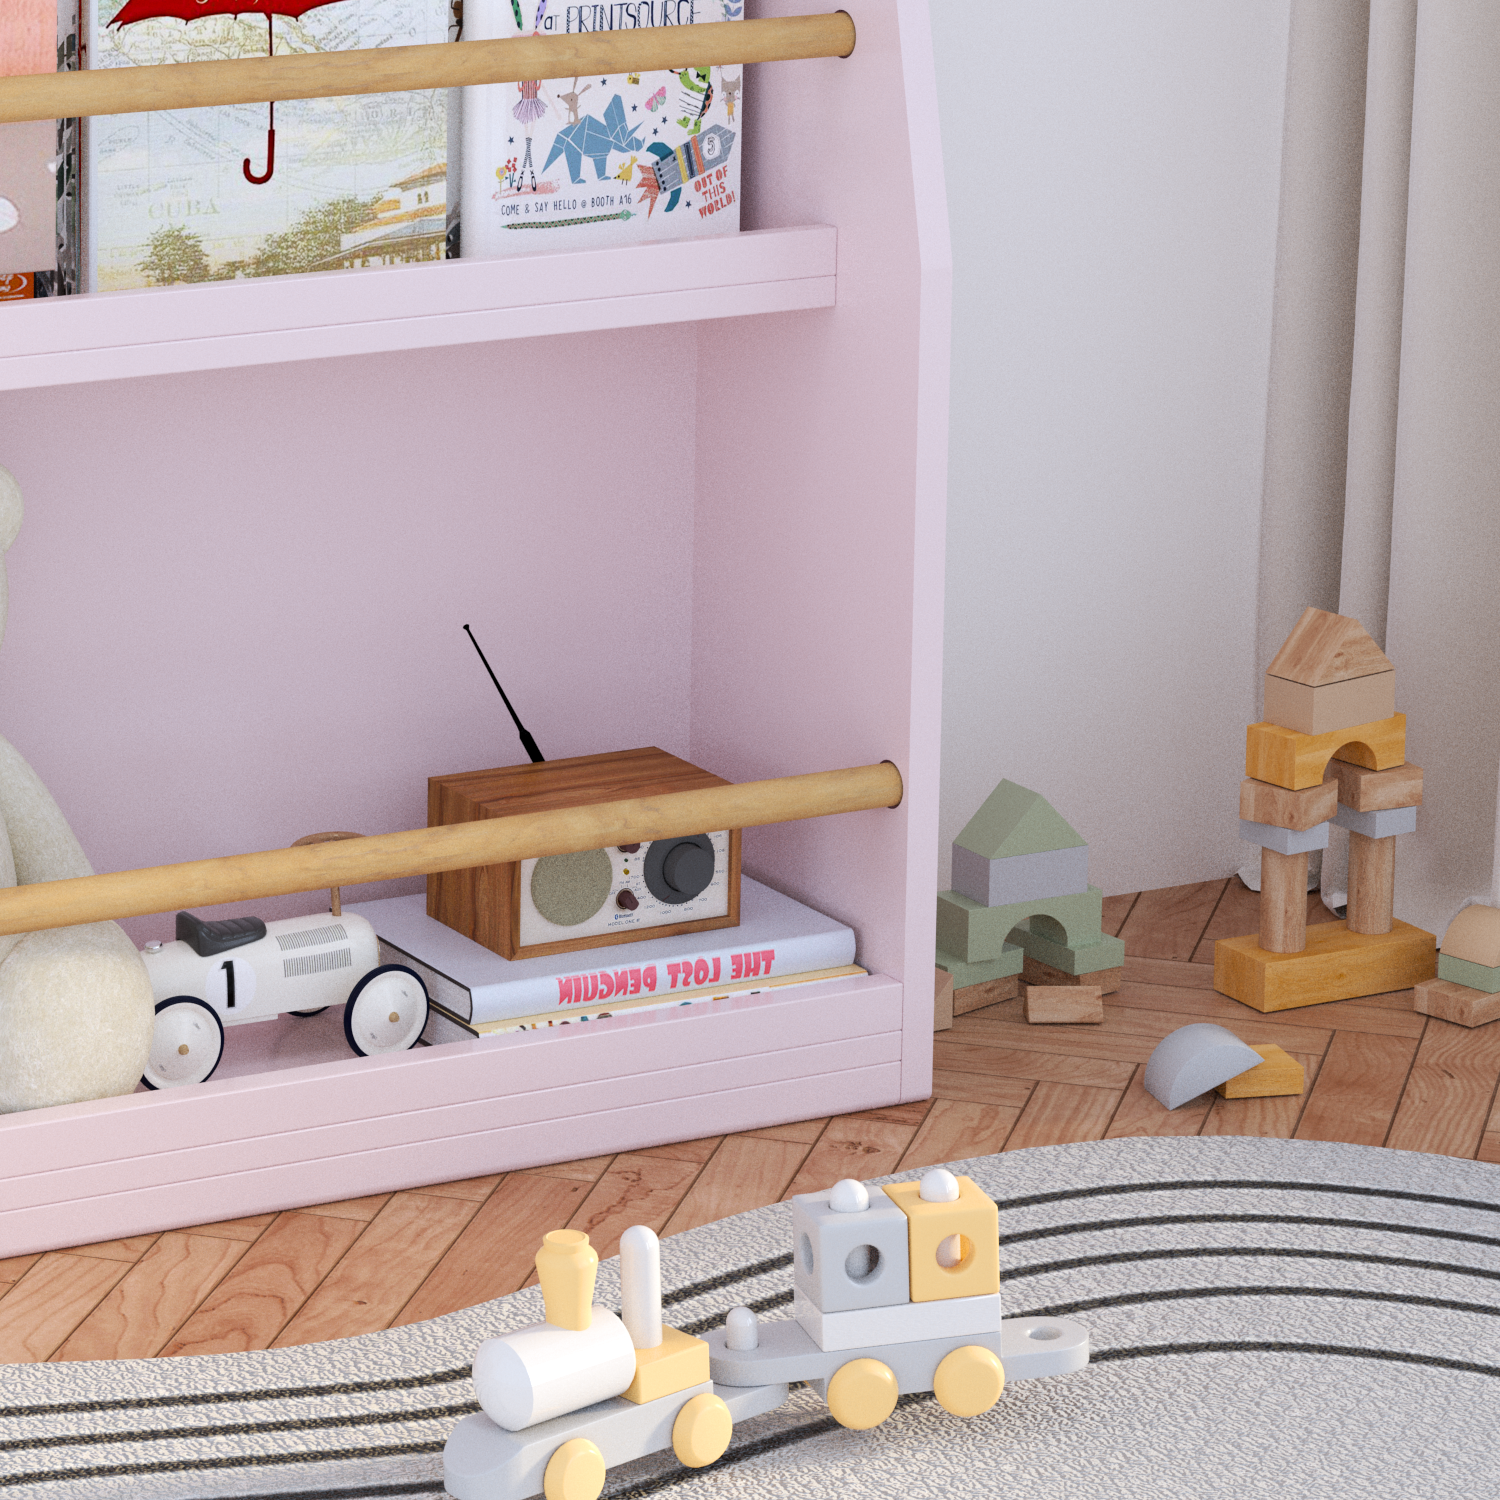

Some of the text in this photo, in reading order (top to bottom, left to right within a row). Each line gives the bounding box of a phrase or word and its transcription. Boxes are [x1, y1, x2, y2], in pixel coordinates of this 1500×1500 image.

[707, 136, 716, 155] 5
[694, 165, 729, 192] OUT OF
[501, 193, 632, 216] COME & SAY HELLO @ BOOTH A16
[701, 182, 728, 203] THIS
[699, 193, 736, 220] WORLD!
[220, 960, 236, 1008] 1
